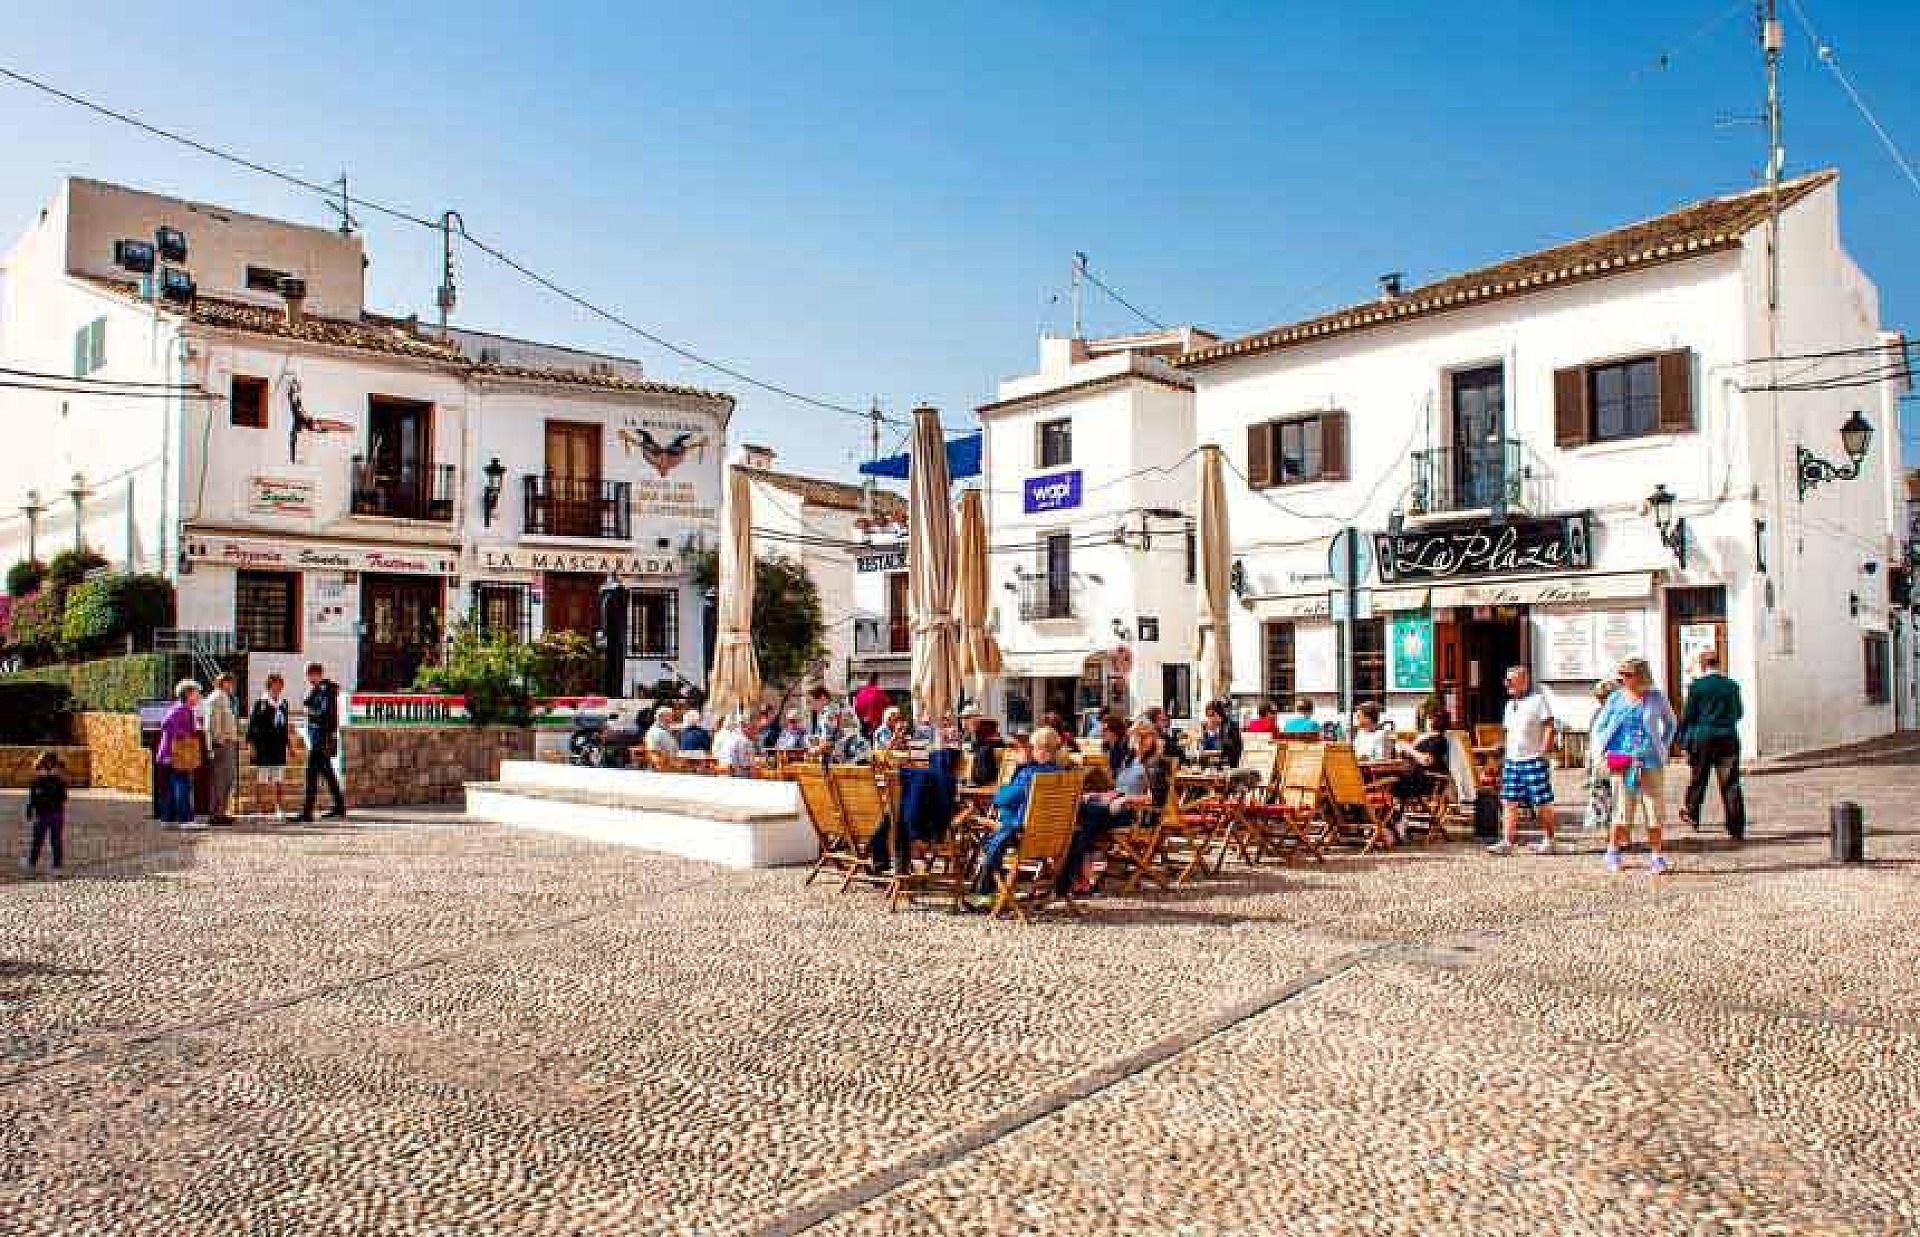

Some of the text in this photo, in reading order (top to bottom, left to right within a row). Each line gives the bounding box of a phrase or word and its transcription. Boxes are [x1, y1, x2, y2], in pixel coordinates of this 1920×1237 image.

[486, 552, 675, 573] LA MASCARADA
[1444, 526, 1568, 575] Plaza
